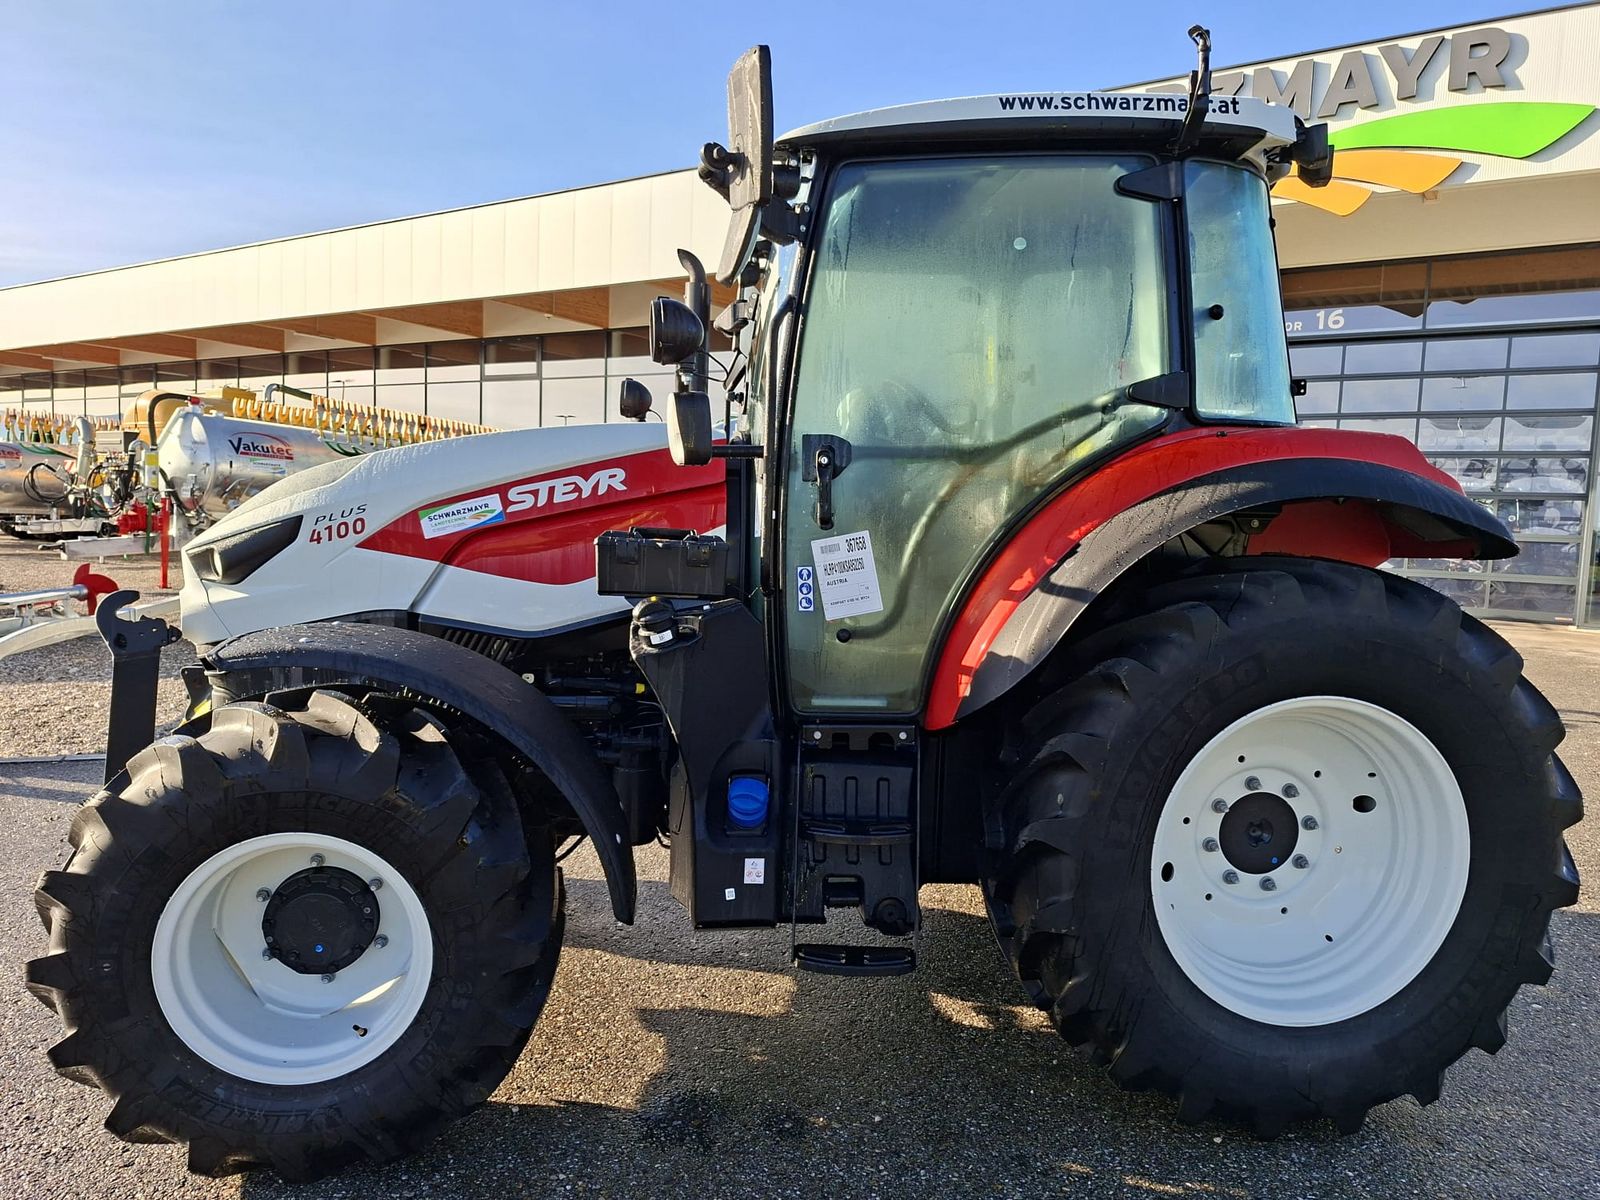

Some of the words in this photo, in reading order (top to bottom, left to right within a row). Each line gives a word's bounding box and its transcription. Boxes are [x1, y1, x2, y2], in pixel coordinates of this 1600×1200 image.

[999, 93, 1240, 115] www.schwarzma.at
[1316, 309, 1345, 330] 16
[228, 437, 294, 456] Vakutec
[506, 467, 627, 513] STEYR
[314, 503, 368, 526] PLUS
[427, 503, 490, 522] SCHWARZMAYR
[309, 517, 366, 545] 4100
[845, 535, 867, 553] 367658
[826, 577, 848, 587] AUSTRIA
